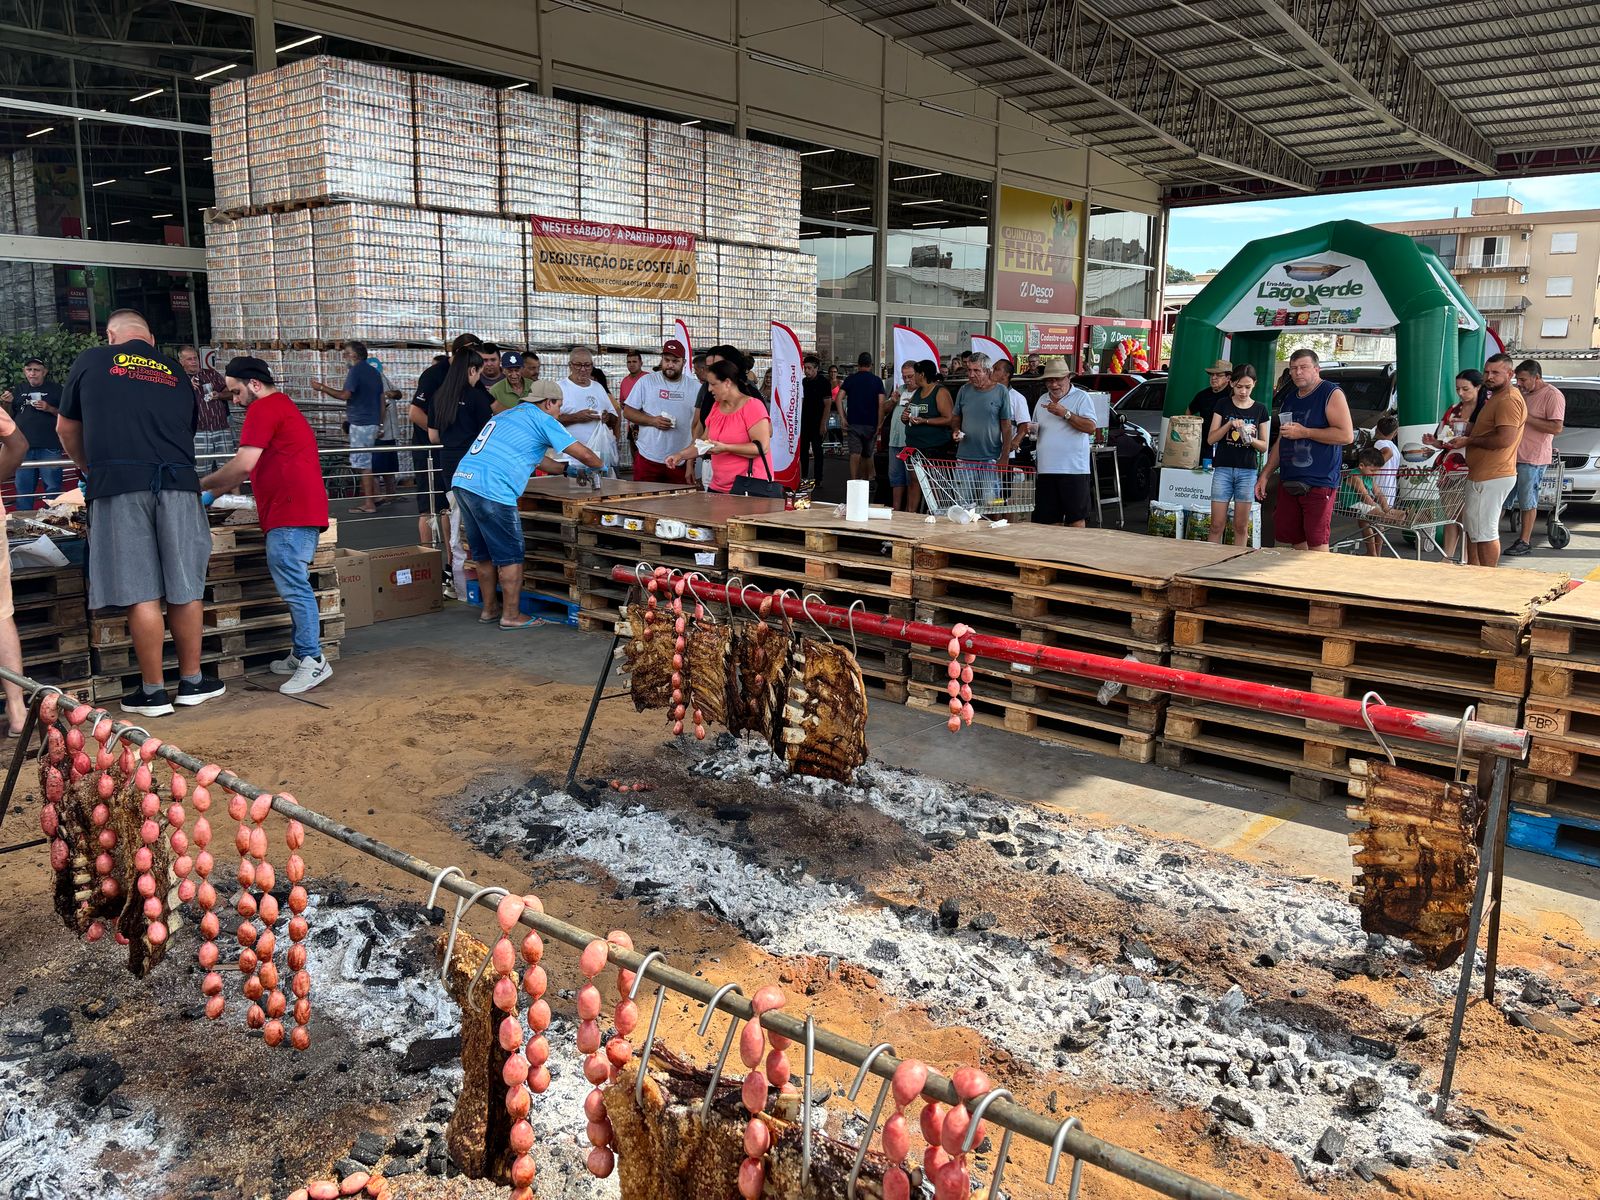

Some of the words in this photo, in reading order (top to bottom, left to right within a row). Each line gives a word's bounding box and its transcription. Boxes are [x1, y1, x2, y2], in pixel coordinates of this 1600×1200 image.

[541, 221, 572, 235] NESTE
[573, 222, 611, 238] SÁBADO
[617, 231, 624, 239] A
[625, 232, 655, 243] PARTIR
[656, 235, 672, 245] DAS
[673, 236, 688, 246] 10H
[1005, 227, 1032, 242] QUINTA
[1032, 233, 1042, 242] DO
[539, 250, 618, 272] DEGUSTAÇÃO
[620, 258, 635, 271] DE
[636, 260, 691, 276] COSTELÃO
[1030, 283, 1054, 298] Desco
[1257, 281, 1305, 302] Lago
[1308, 279, 1363, 298] Verde
[1004, 334, 1024, 343] VOLTOU
[1040, 333, 1065, 342] Cadastre-se
[470, 420, 497, 455] 9
[1174, 485, 1204, 494] verdadeiro
[1529, 715, 1553, 729] PBR
